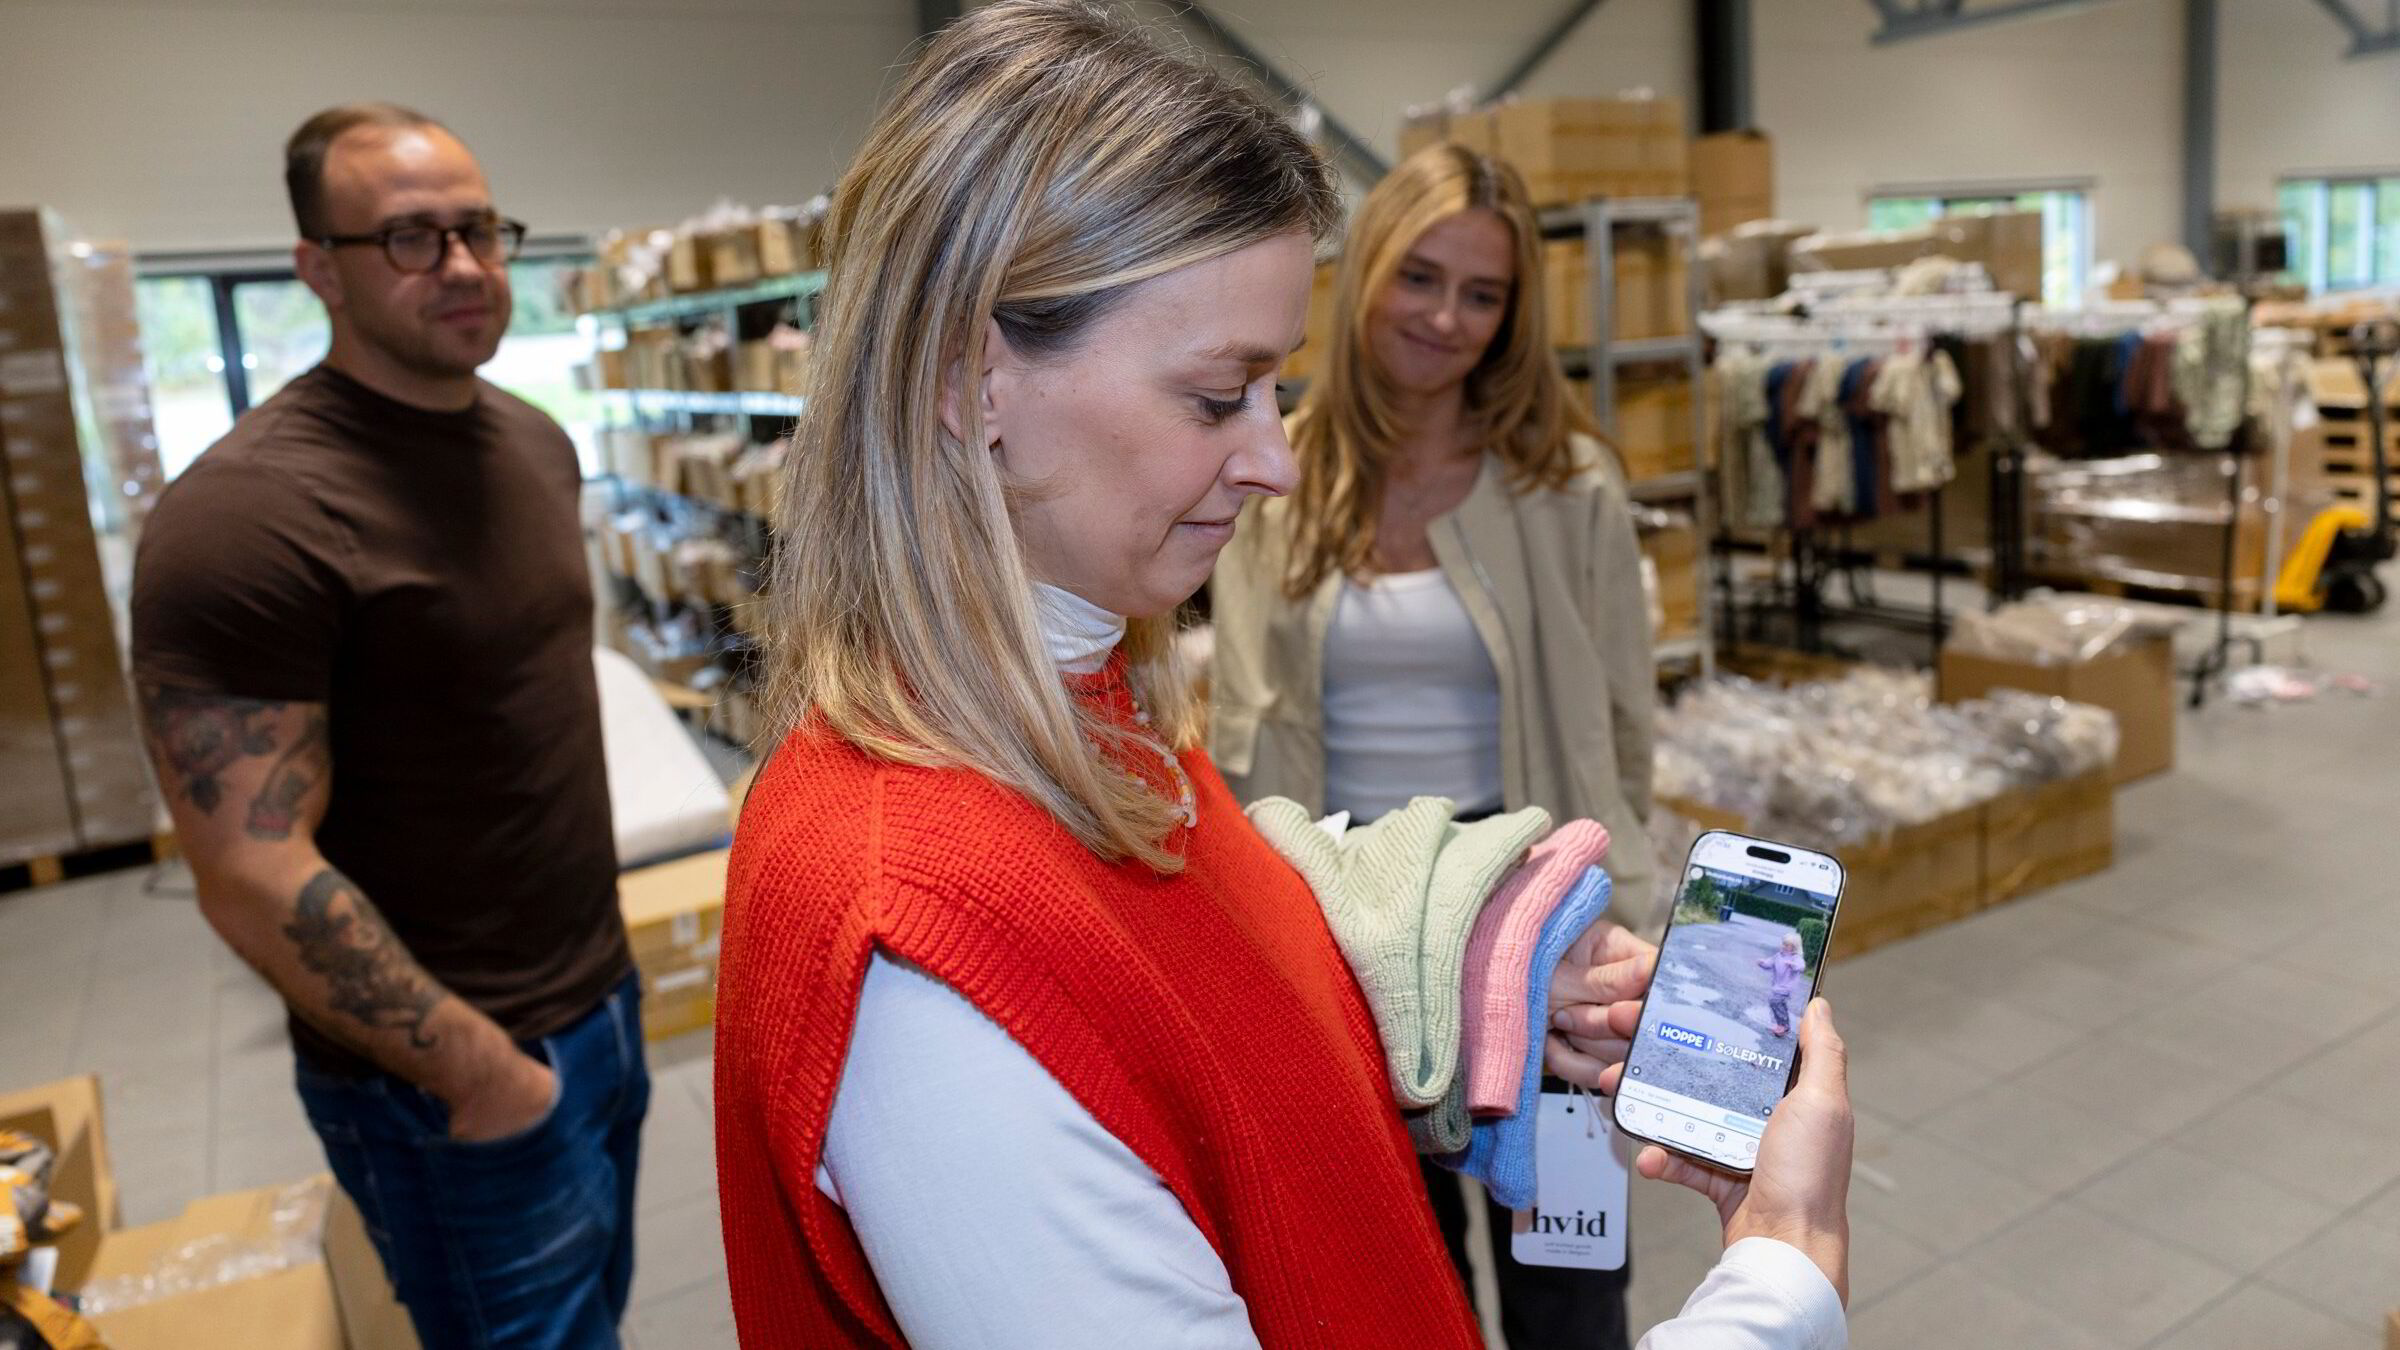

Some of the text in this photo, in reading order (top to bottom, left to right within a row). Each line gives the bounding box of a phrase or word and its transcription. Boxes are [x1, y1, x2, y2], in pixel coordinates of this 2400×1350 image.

[1660, 1025, 1705, 1048] HOPPE
[1706, 1039, 1713, 1050] I
[1715, 1042, 1783, 1071] SØLEPYTT
[1531, 1206, 1607, 1238] hvid
